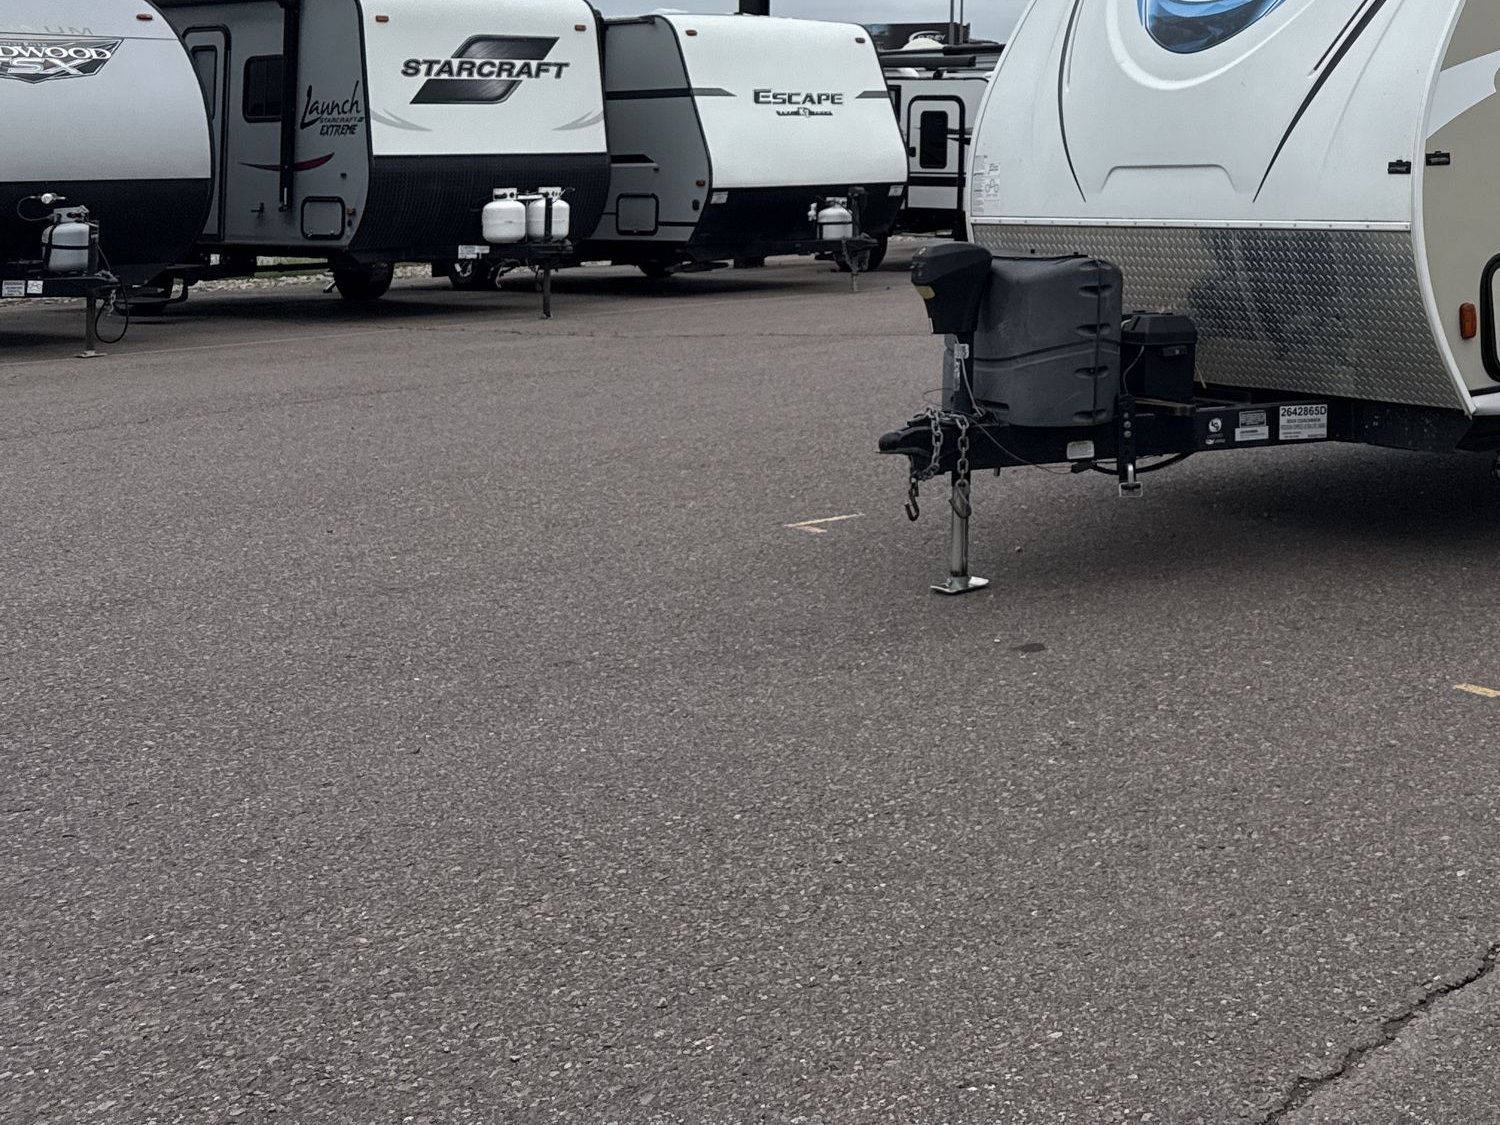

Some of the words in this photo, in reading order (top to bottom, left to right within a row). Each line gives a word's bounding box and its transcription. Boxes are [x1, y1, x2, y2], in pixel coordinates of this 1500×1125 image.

[400, 58, 570, 79] STARCRAFT
[300, 80, 361, 130] Launch
[753, 89, 843, 105] ESCAPE
[320, 124, 358, 136] EXTREME
[1280, 406, 1327, 417] 2642865D
